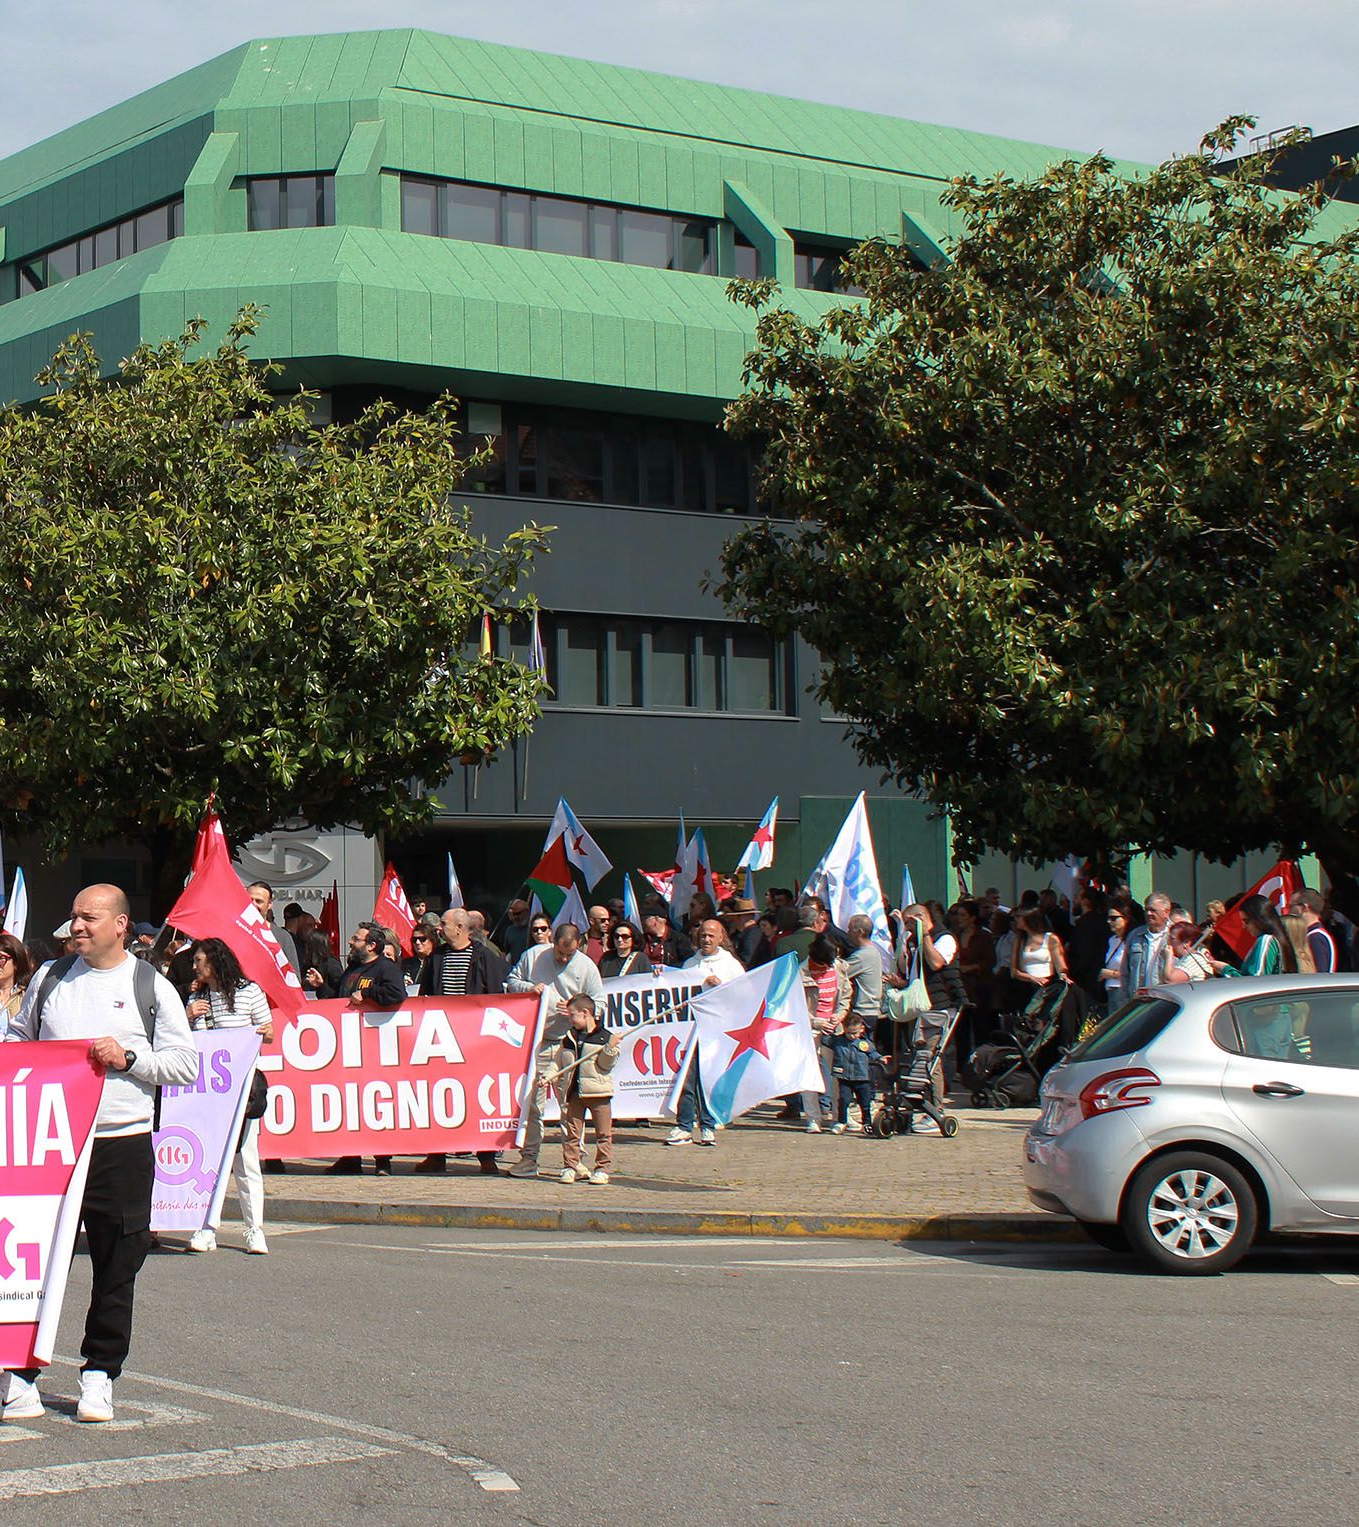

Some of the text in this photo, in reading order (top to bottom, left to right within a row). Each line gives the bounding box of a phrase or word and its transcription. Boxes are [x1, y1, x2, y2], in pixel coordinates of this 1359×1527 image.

[294, 888, 323, 901] MAR
[310, 1077, 466, 1133] DIGNO
[157, 1146, 190, 1166] CIG
